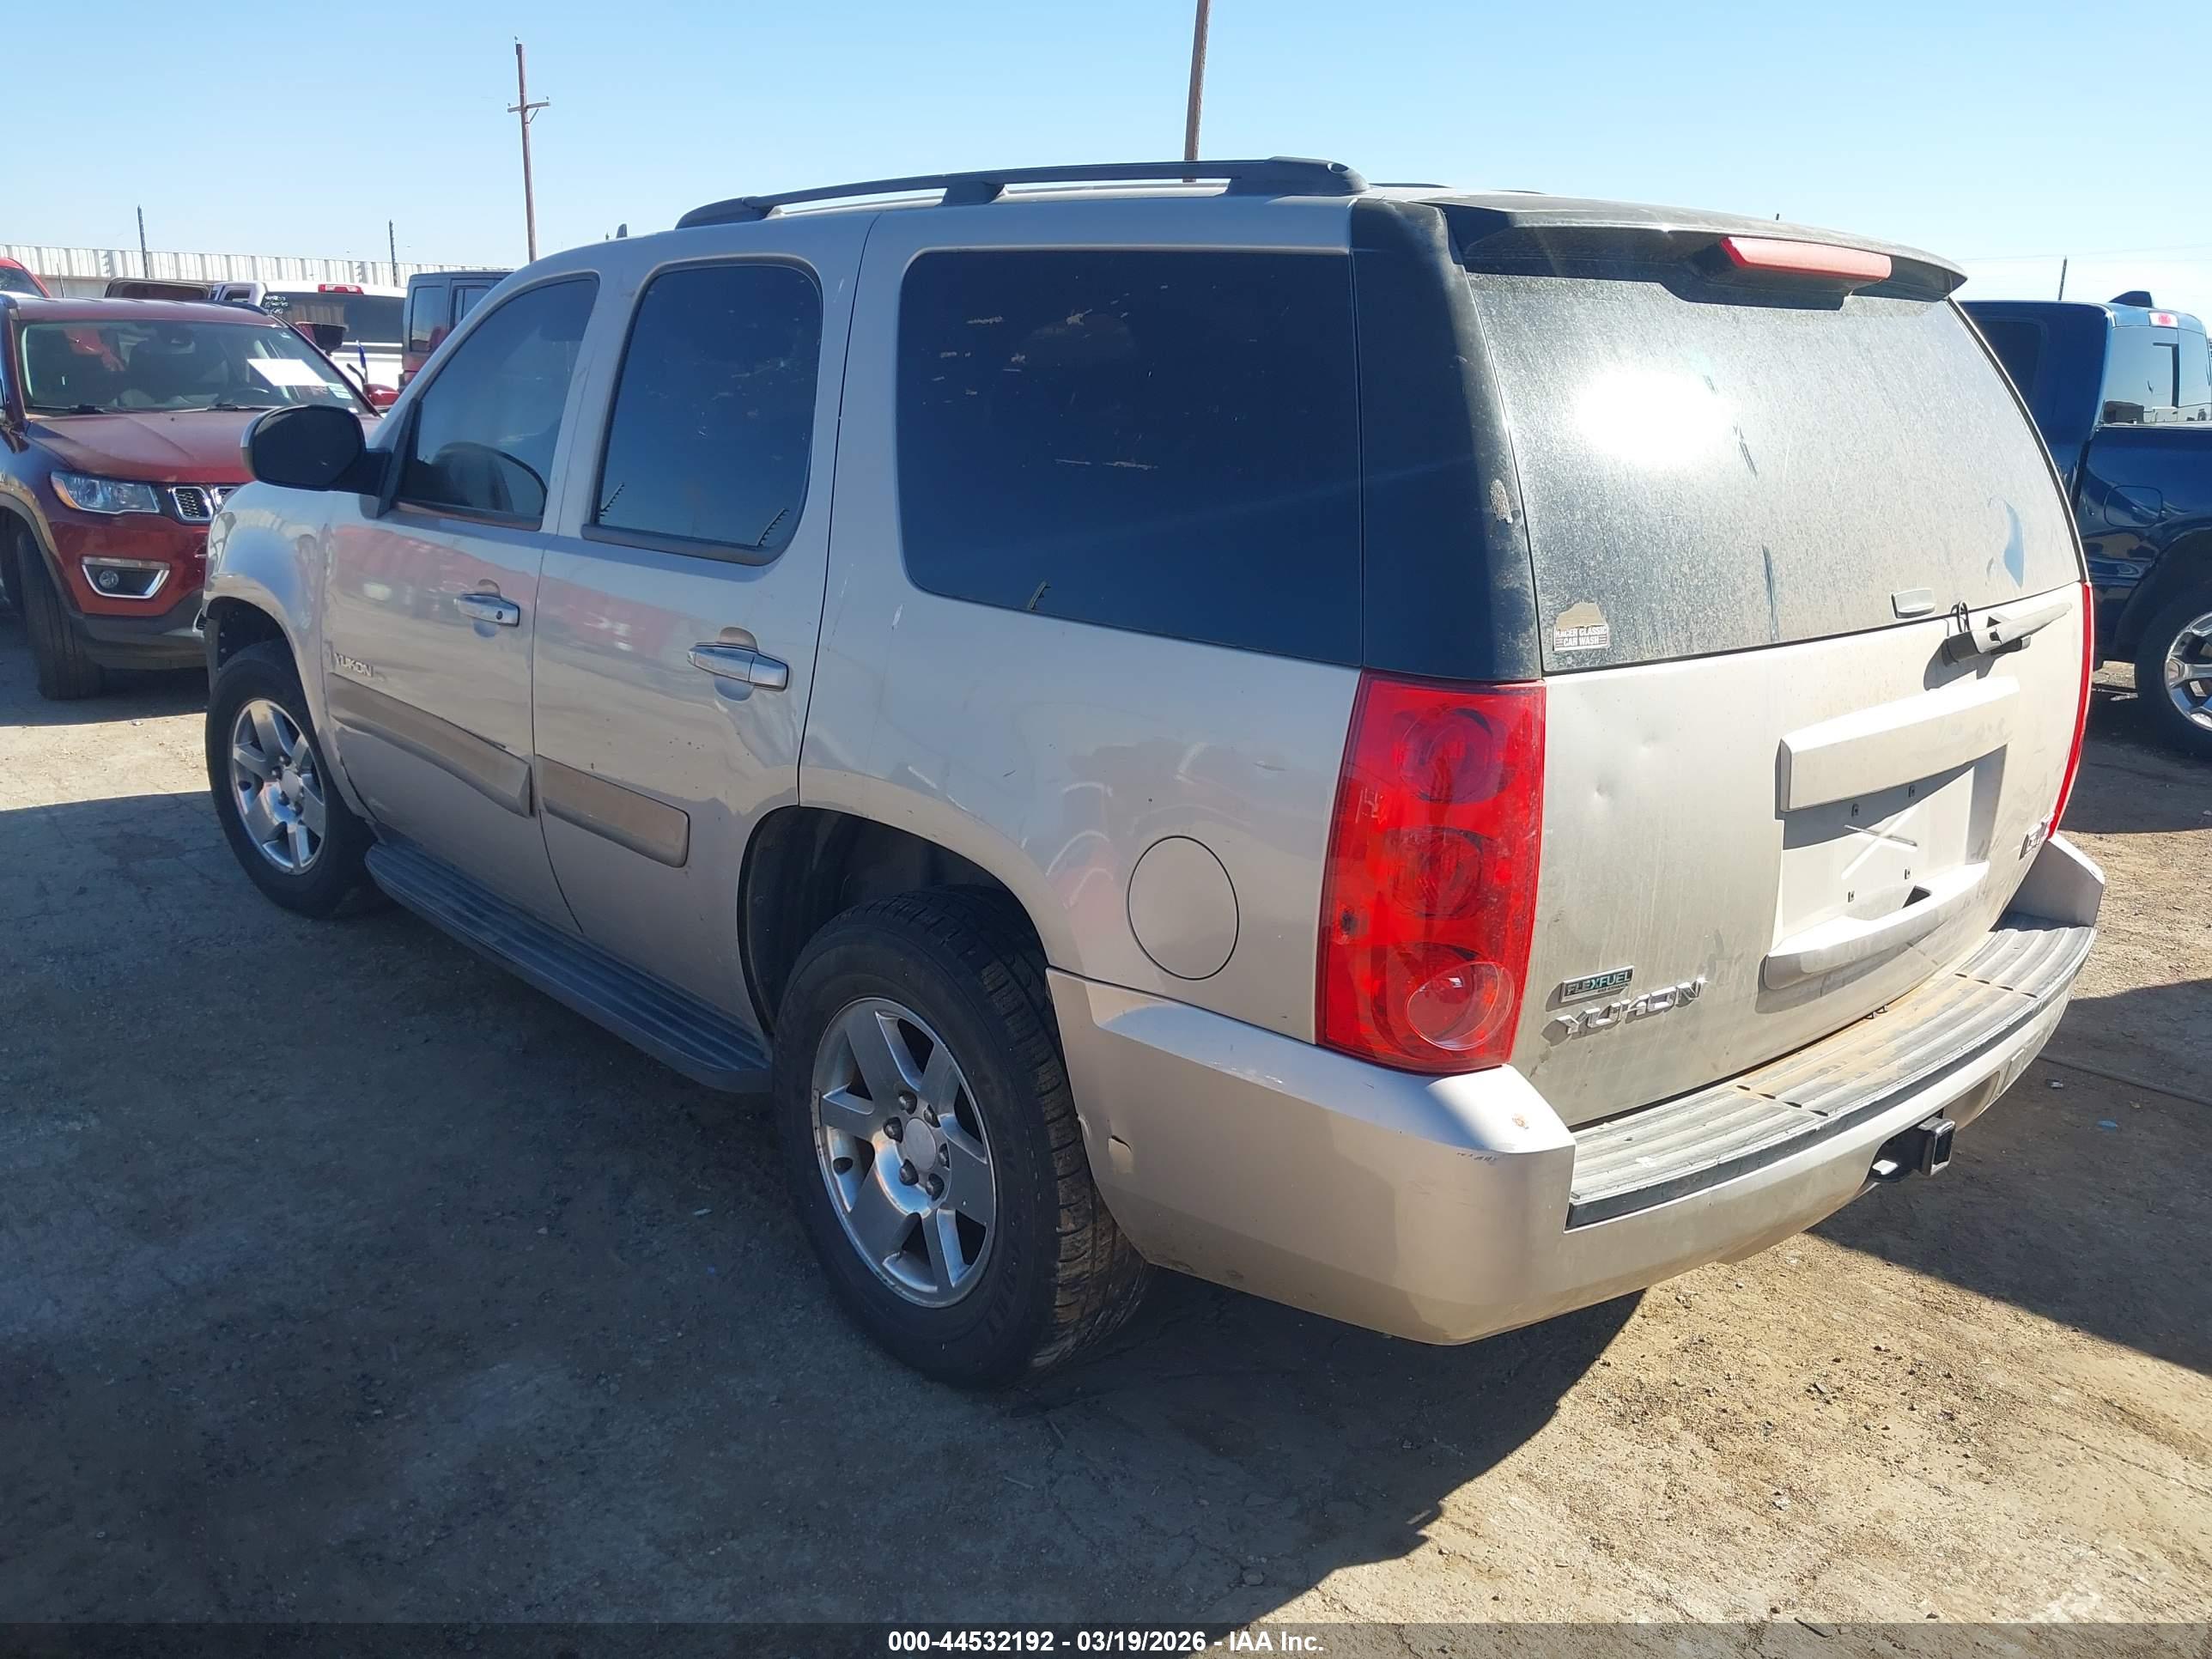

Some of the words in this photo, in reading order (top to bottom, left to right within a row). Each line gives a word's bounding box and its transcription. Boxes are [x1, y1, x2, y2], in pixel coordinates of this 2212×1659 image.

[1563, 637, 1578, 647] CAR
[1579, 635, 1600, 646] WASH
[1579, 626, 1607, 637] CLASSIC
[334, 652, 374, 678] YUKON
[1565, 970, 1632, 996] FLEXFUEL
[1556, 977, 1705, 1035] YUKON
